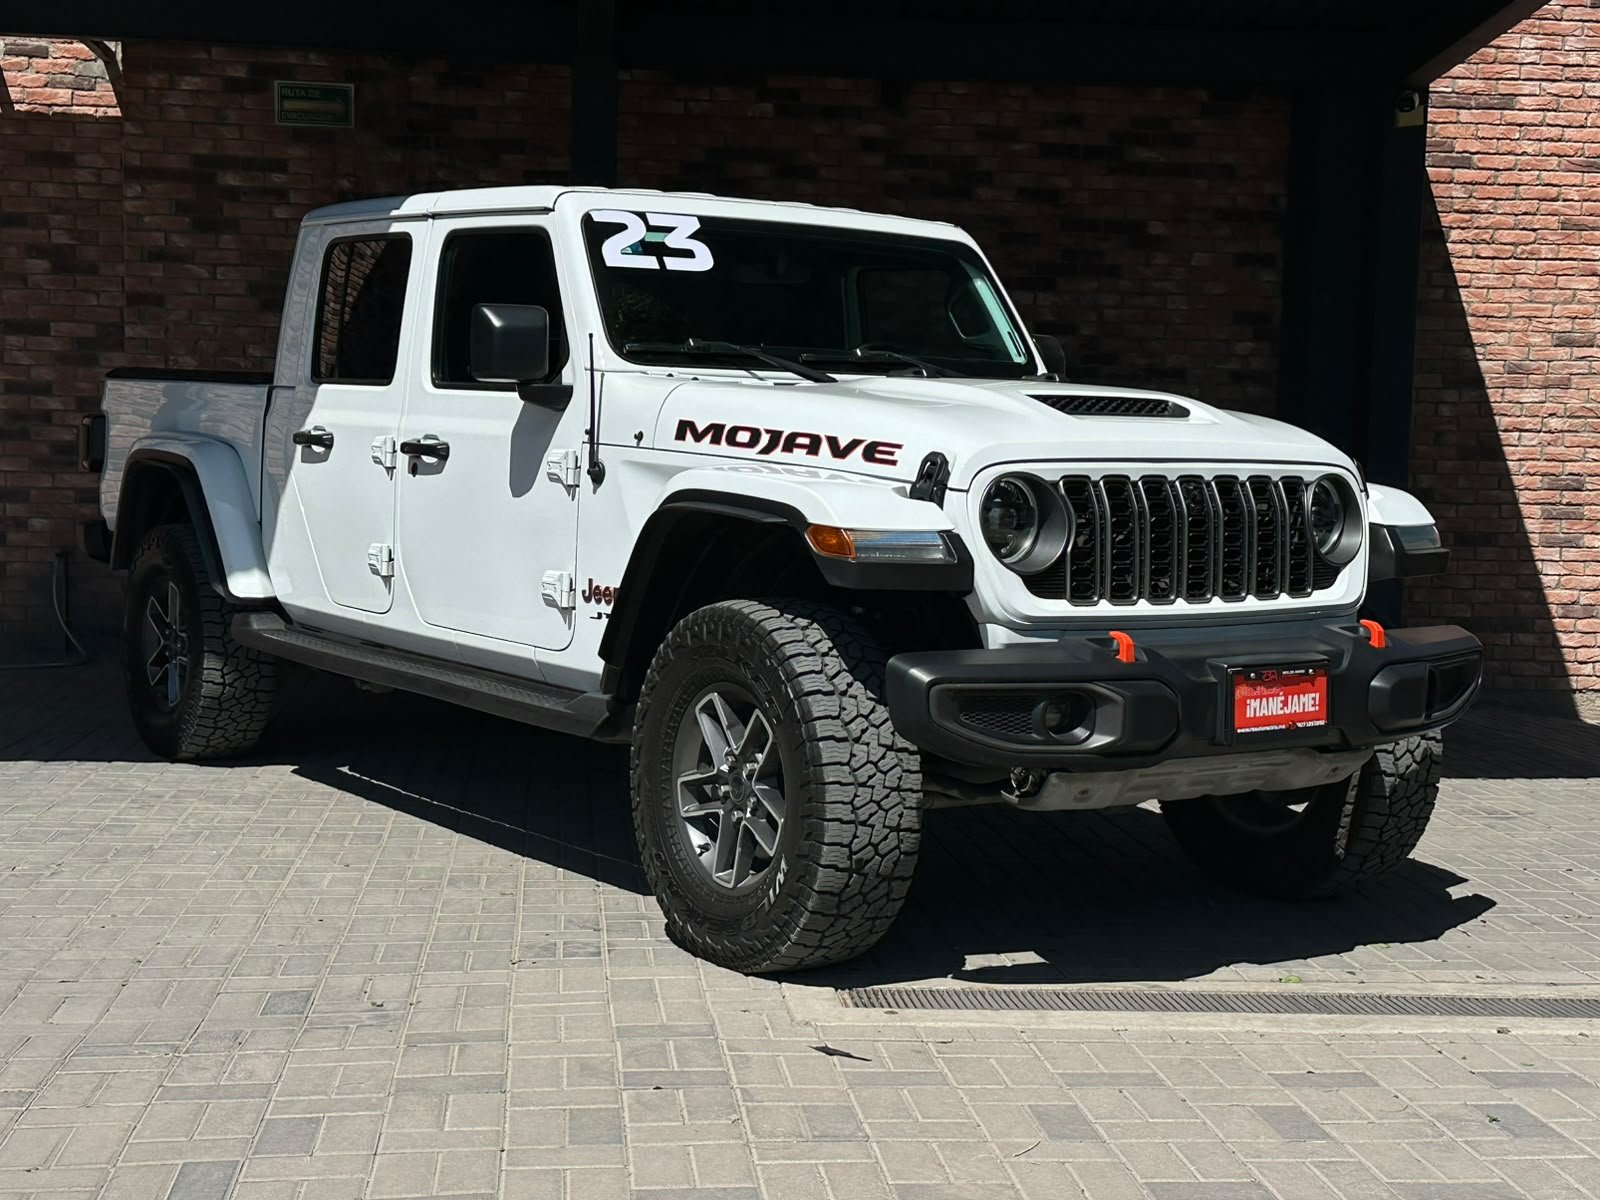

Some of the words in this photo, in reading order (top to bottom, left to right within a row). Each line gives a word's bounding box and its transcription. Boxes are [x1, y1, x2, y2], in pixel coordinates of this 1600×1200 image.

[282, 87, 306, 97] RUTA
[588, 209, 714, 271] 23
[674, 419, 904, 467] MOJAVE
[1245, 691, 1320, 718] ¡MANÉJAME!
